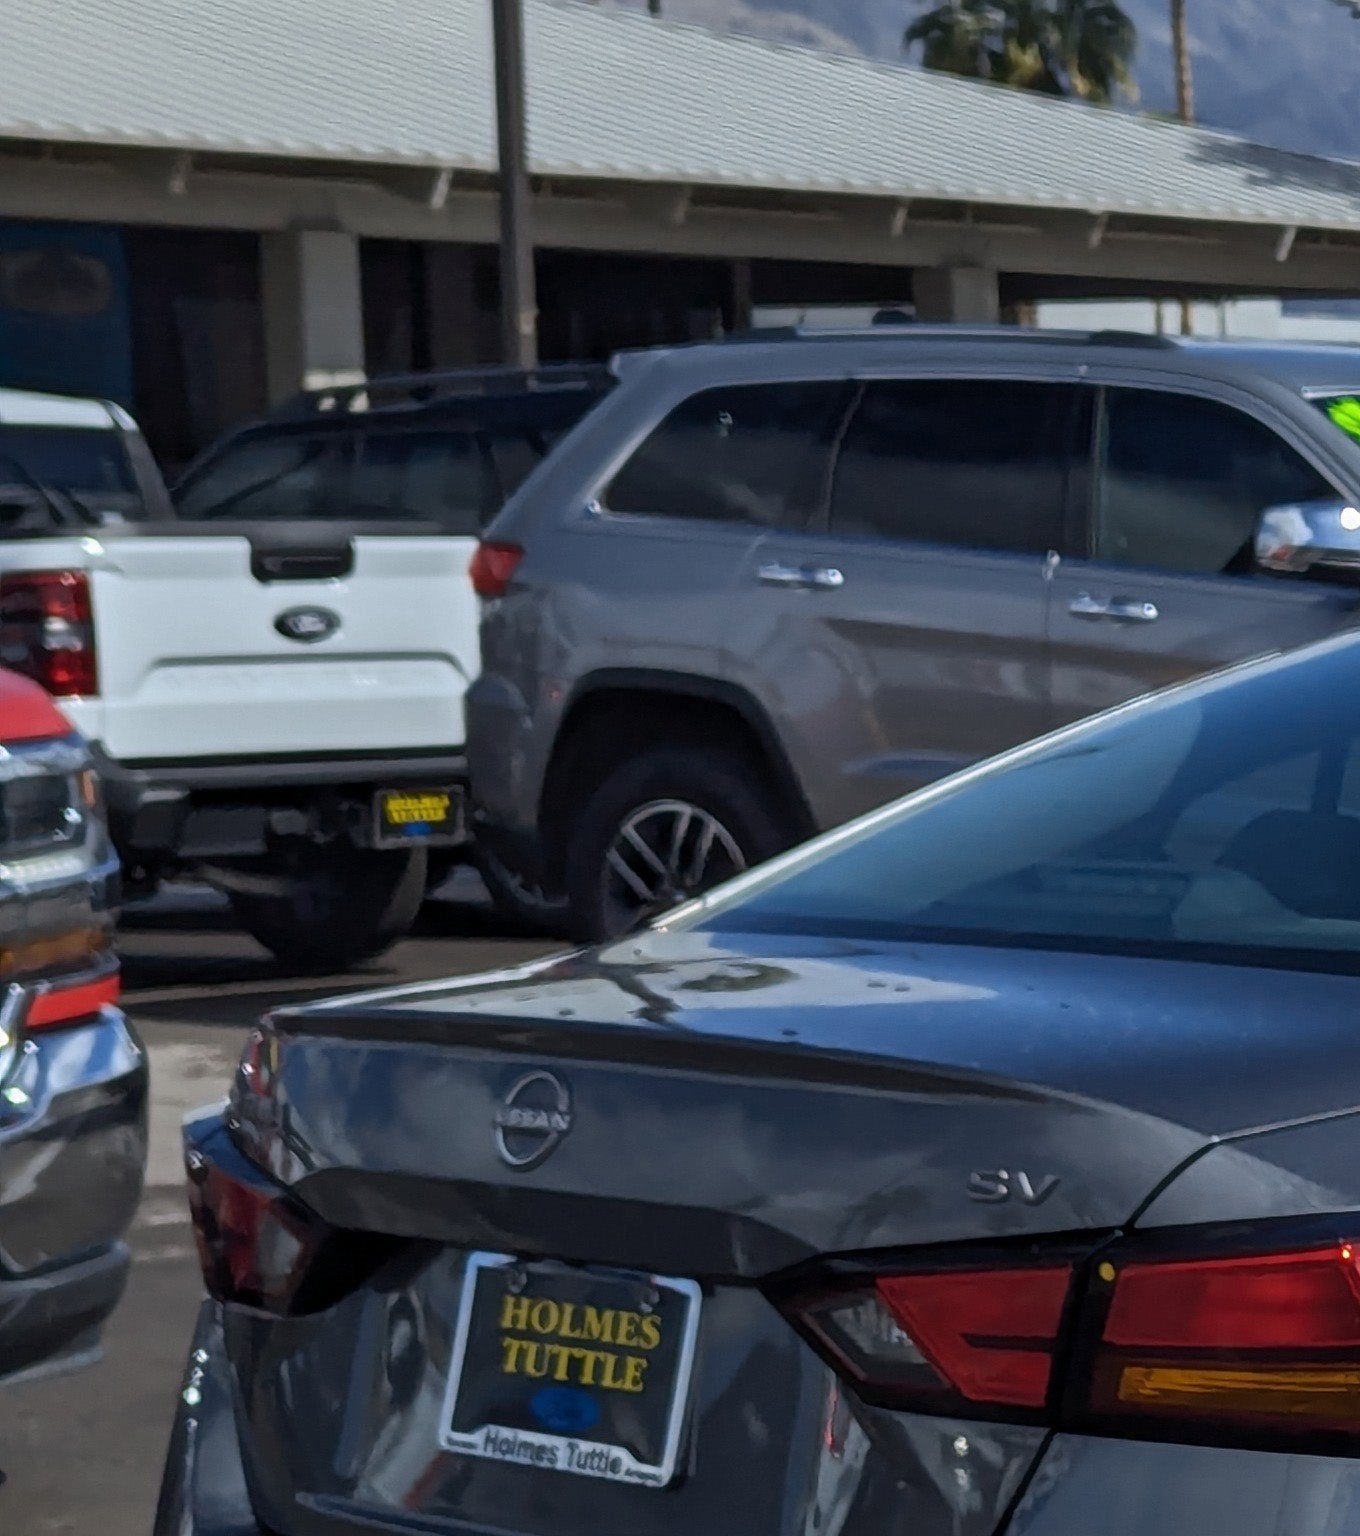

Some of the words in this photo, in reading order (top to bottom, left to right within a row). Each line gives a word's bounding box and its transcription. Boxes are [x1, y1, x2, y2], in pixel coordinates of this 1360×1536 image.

[967, 1169, 1059, 1203] SV
[501, 1295, 661, 1350] HOLMES
[503, 1337, 648, 1392] TUTTLE
[484, 1429, 559, 1466] Holmes
[566, 1442, 622, 1474] Tuttle
